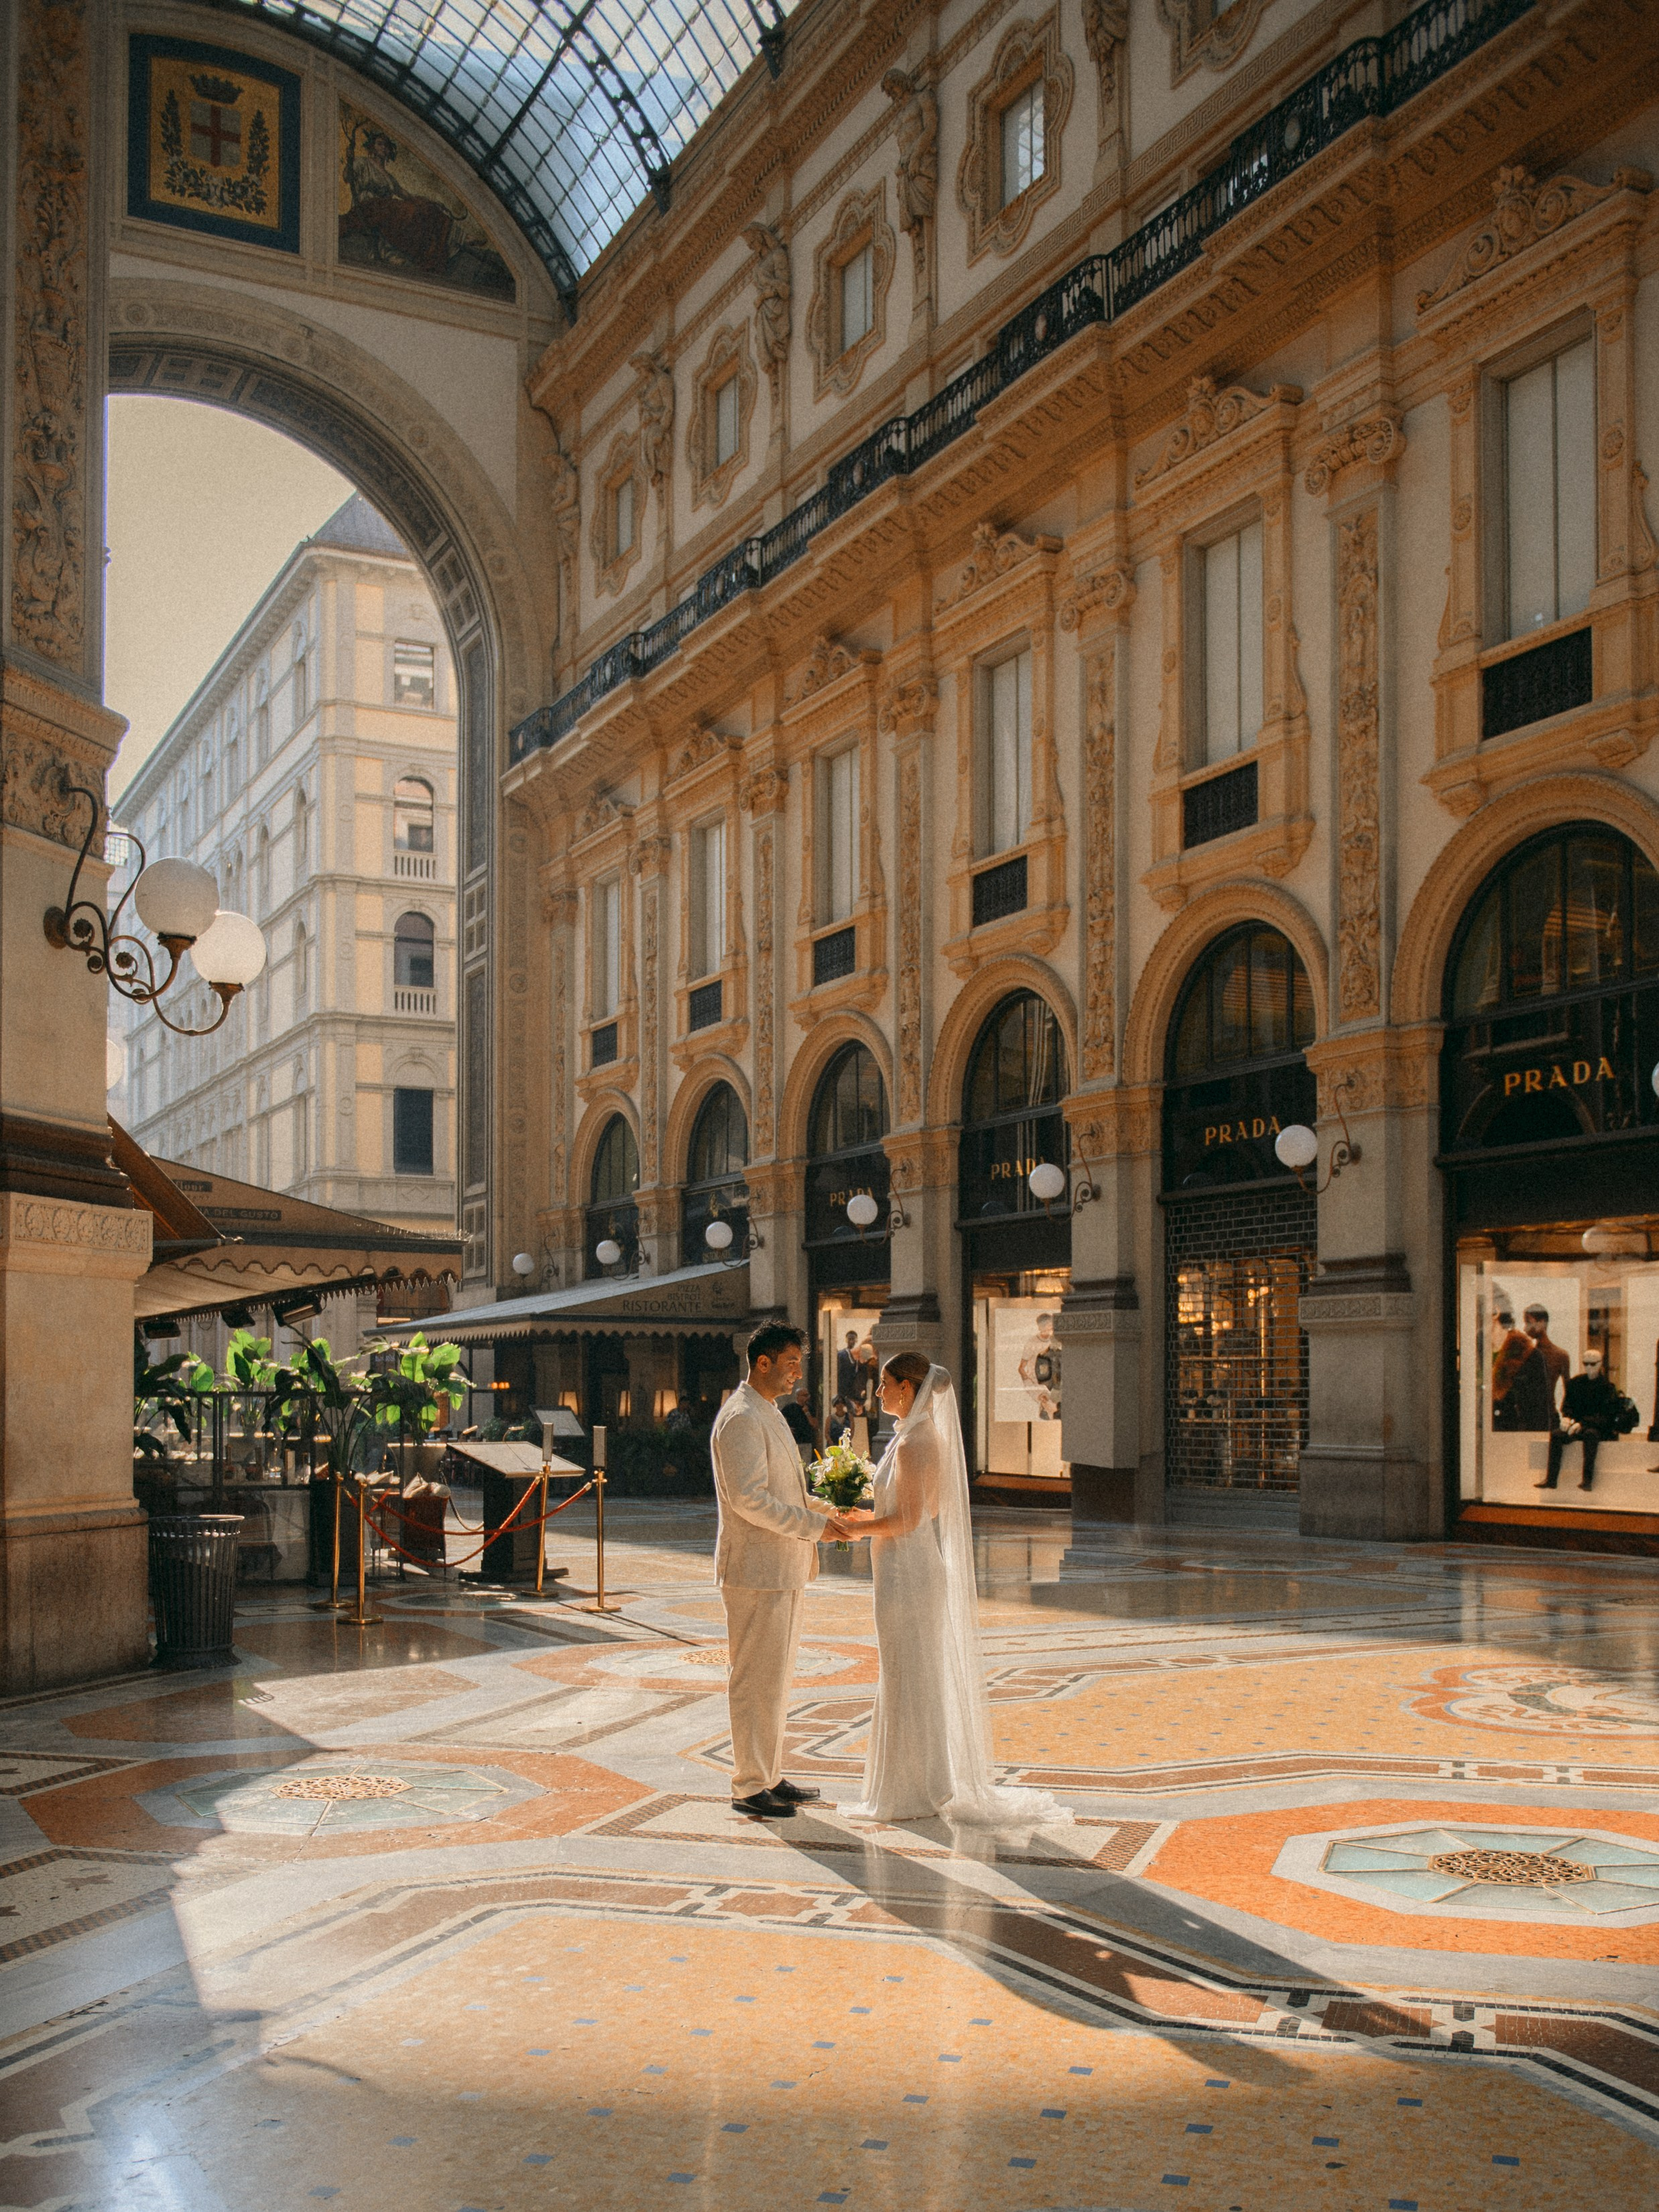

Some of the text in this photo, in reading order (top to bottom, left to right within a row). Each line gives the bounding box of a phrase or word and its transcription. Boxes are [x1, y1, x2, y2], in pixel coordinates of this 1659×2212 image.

[1504, 1056, 1615, 1096] PRADA
[1205, 1115, 1282, 1146] PRADA
[991, 1156, 1046, 1180] PRAD
[214, 1209, 236, 1217] DEL
[240, 1210, 278, 1219] GUSTO
[623, 1300, 702, 1313] RISTORANTE
